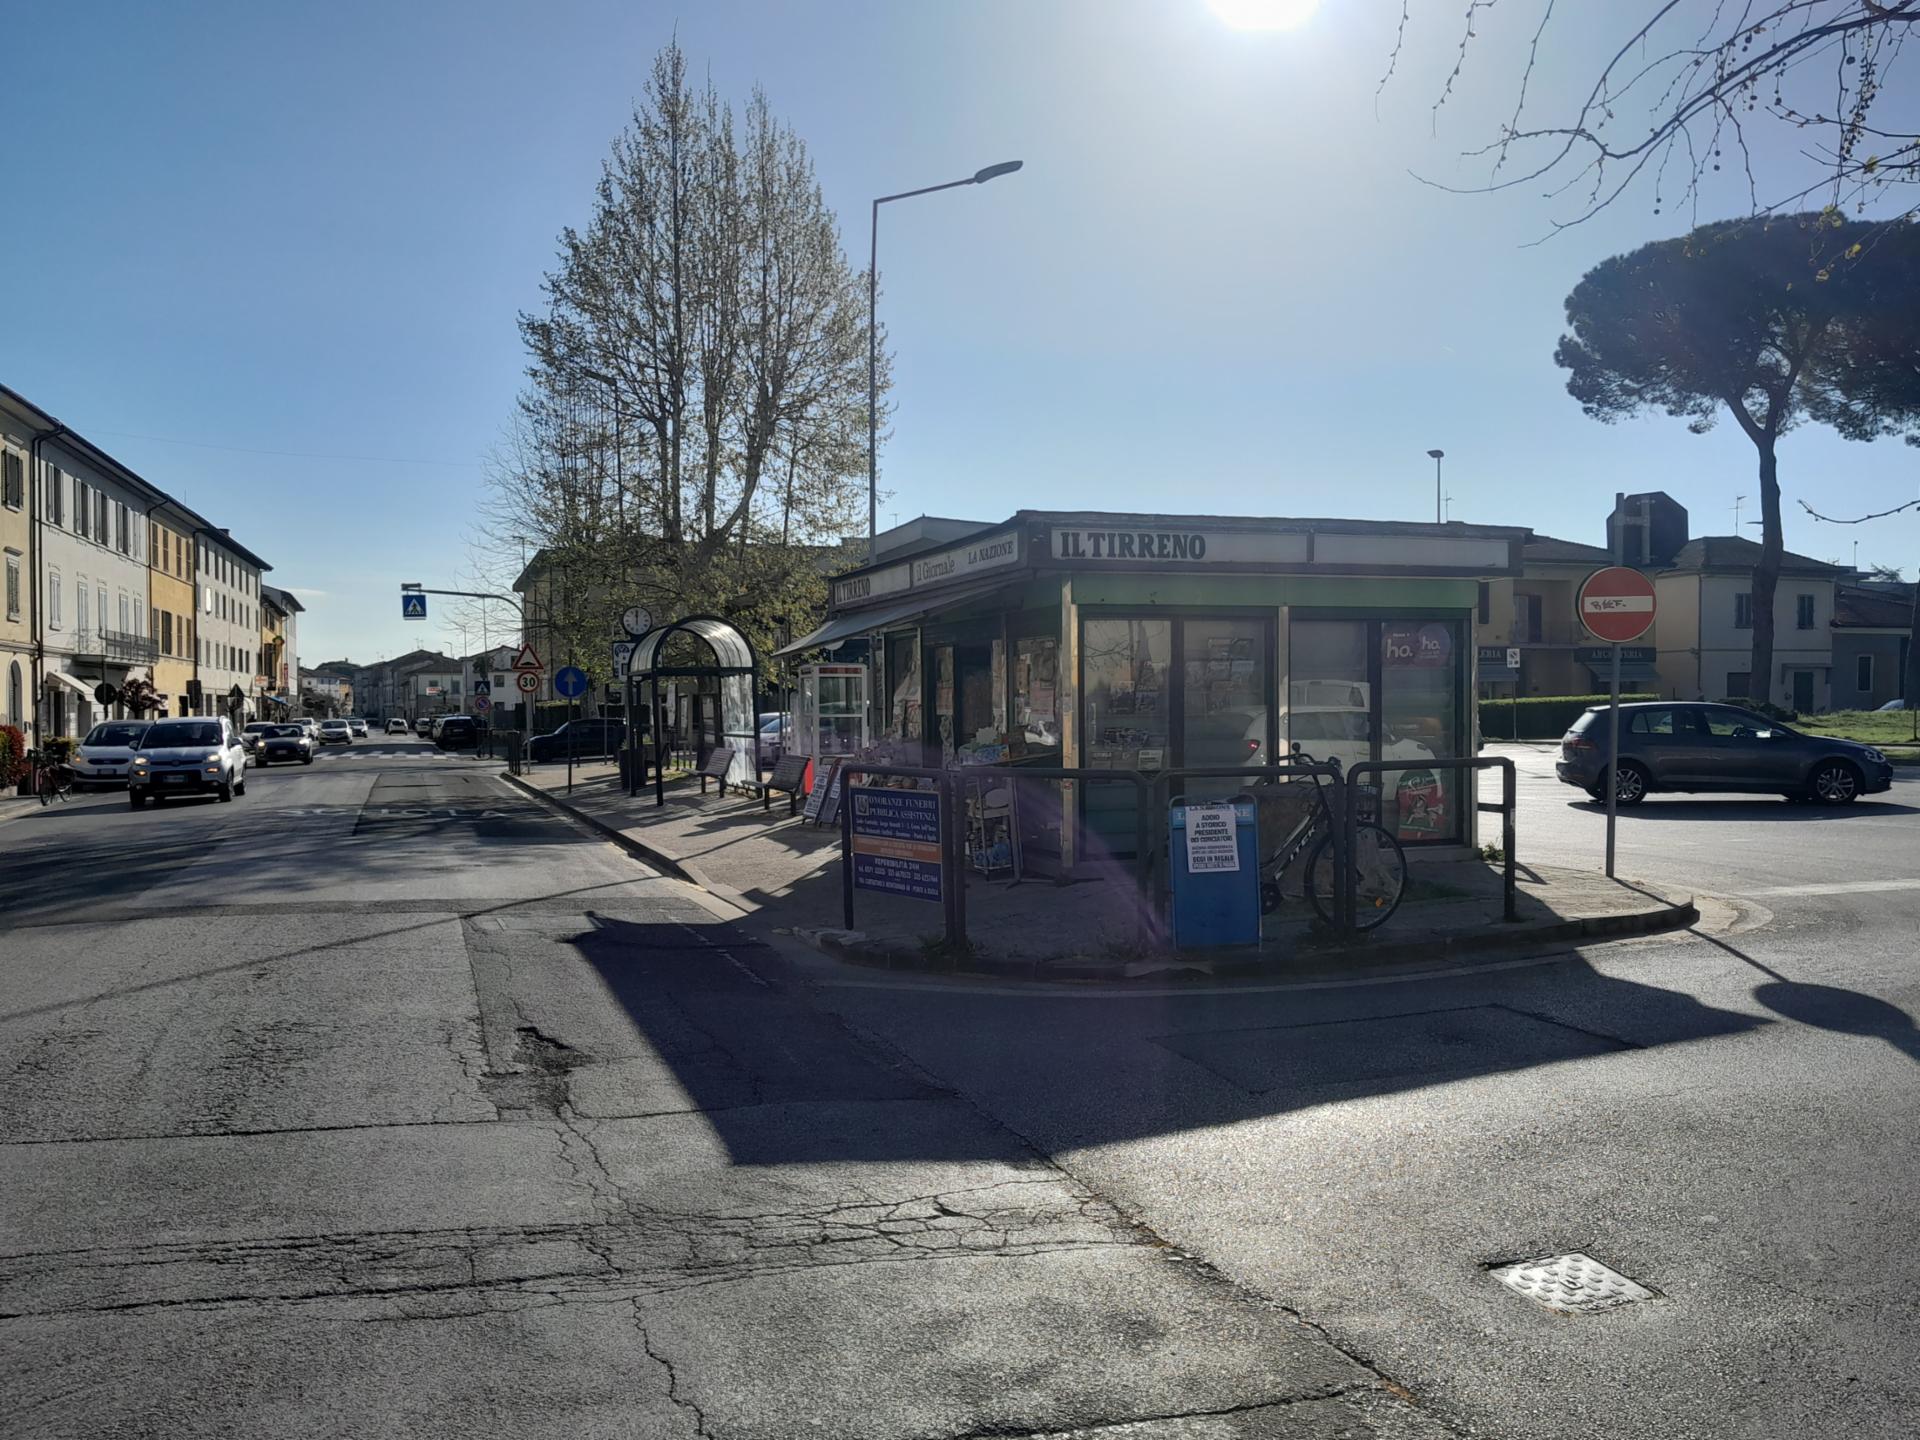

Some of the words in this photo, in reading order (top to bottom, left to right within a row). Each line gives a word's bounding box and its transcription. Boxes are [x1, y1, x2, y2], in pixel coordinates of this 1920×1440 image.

[968, 551, 977, 565] LA
[978, 540, 1014, 562] NAZIONE
[1060, 532, 1085, 558] IL
[1087, 532, 1206, 560] TIRRENO
[922, 555, 956, 579] Giornale
[842, 577, 871, 602] TIRRENO
[522, 677, 536, 688] 30
[1194, 828, 1229, 836] PRESIDENTE
